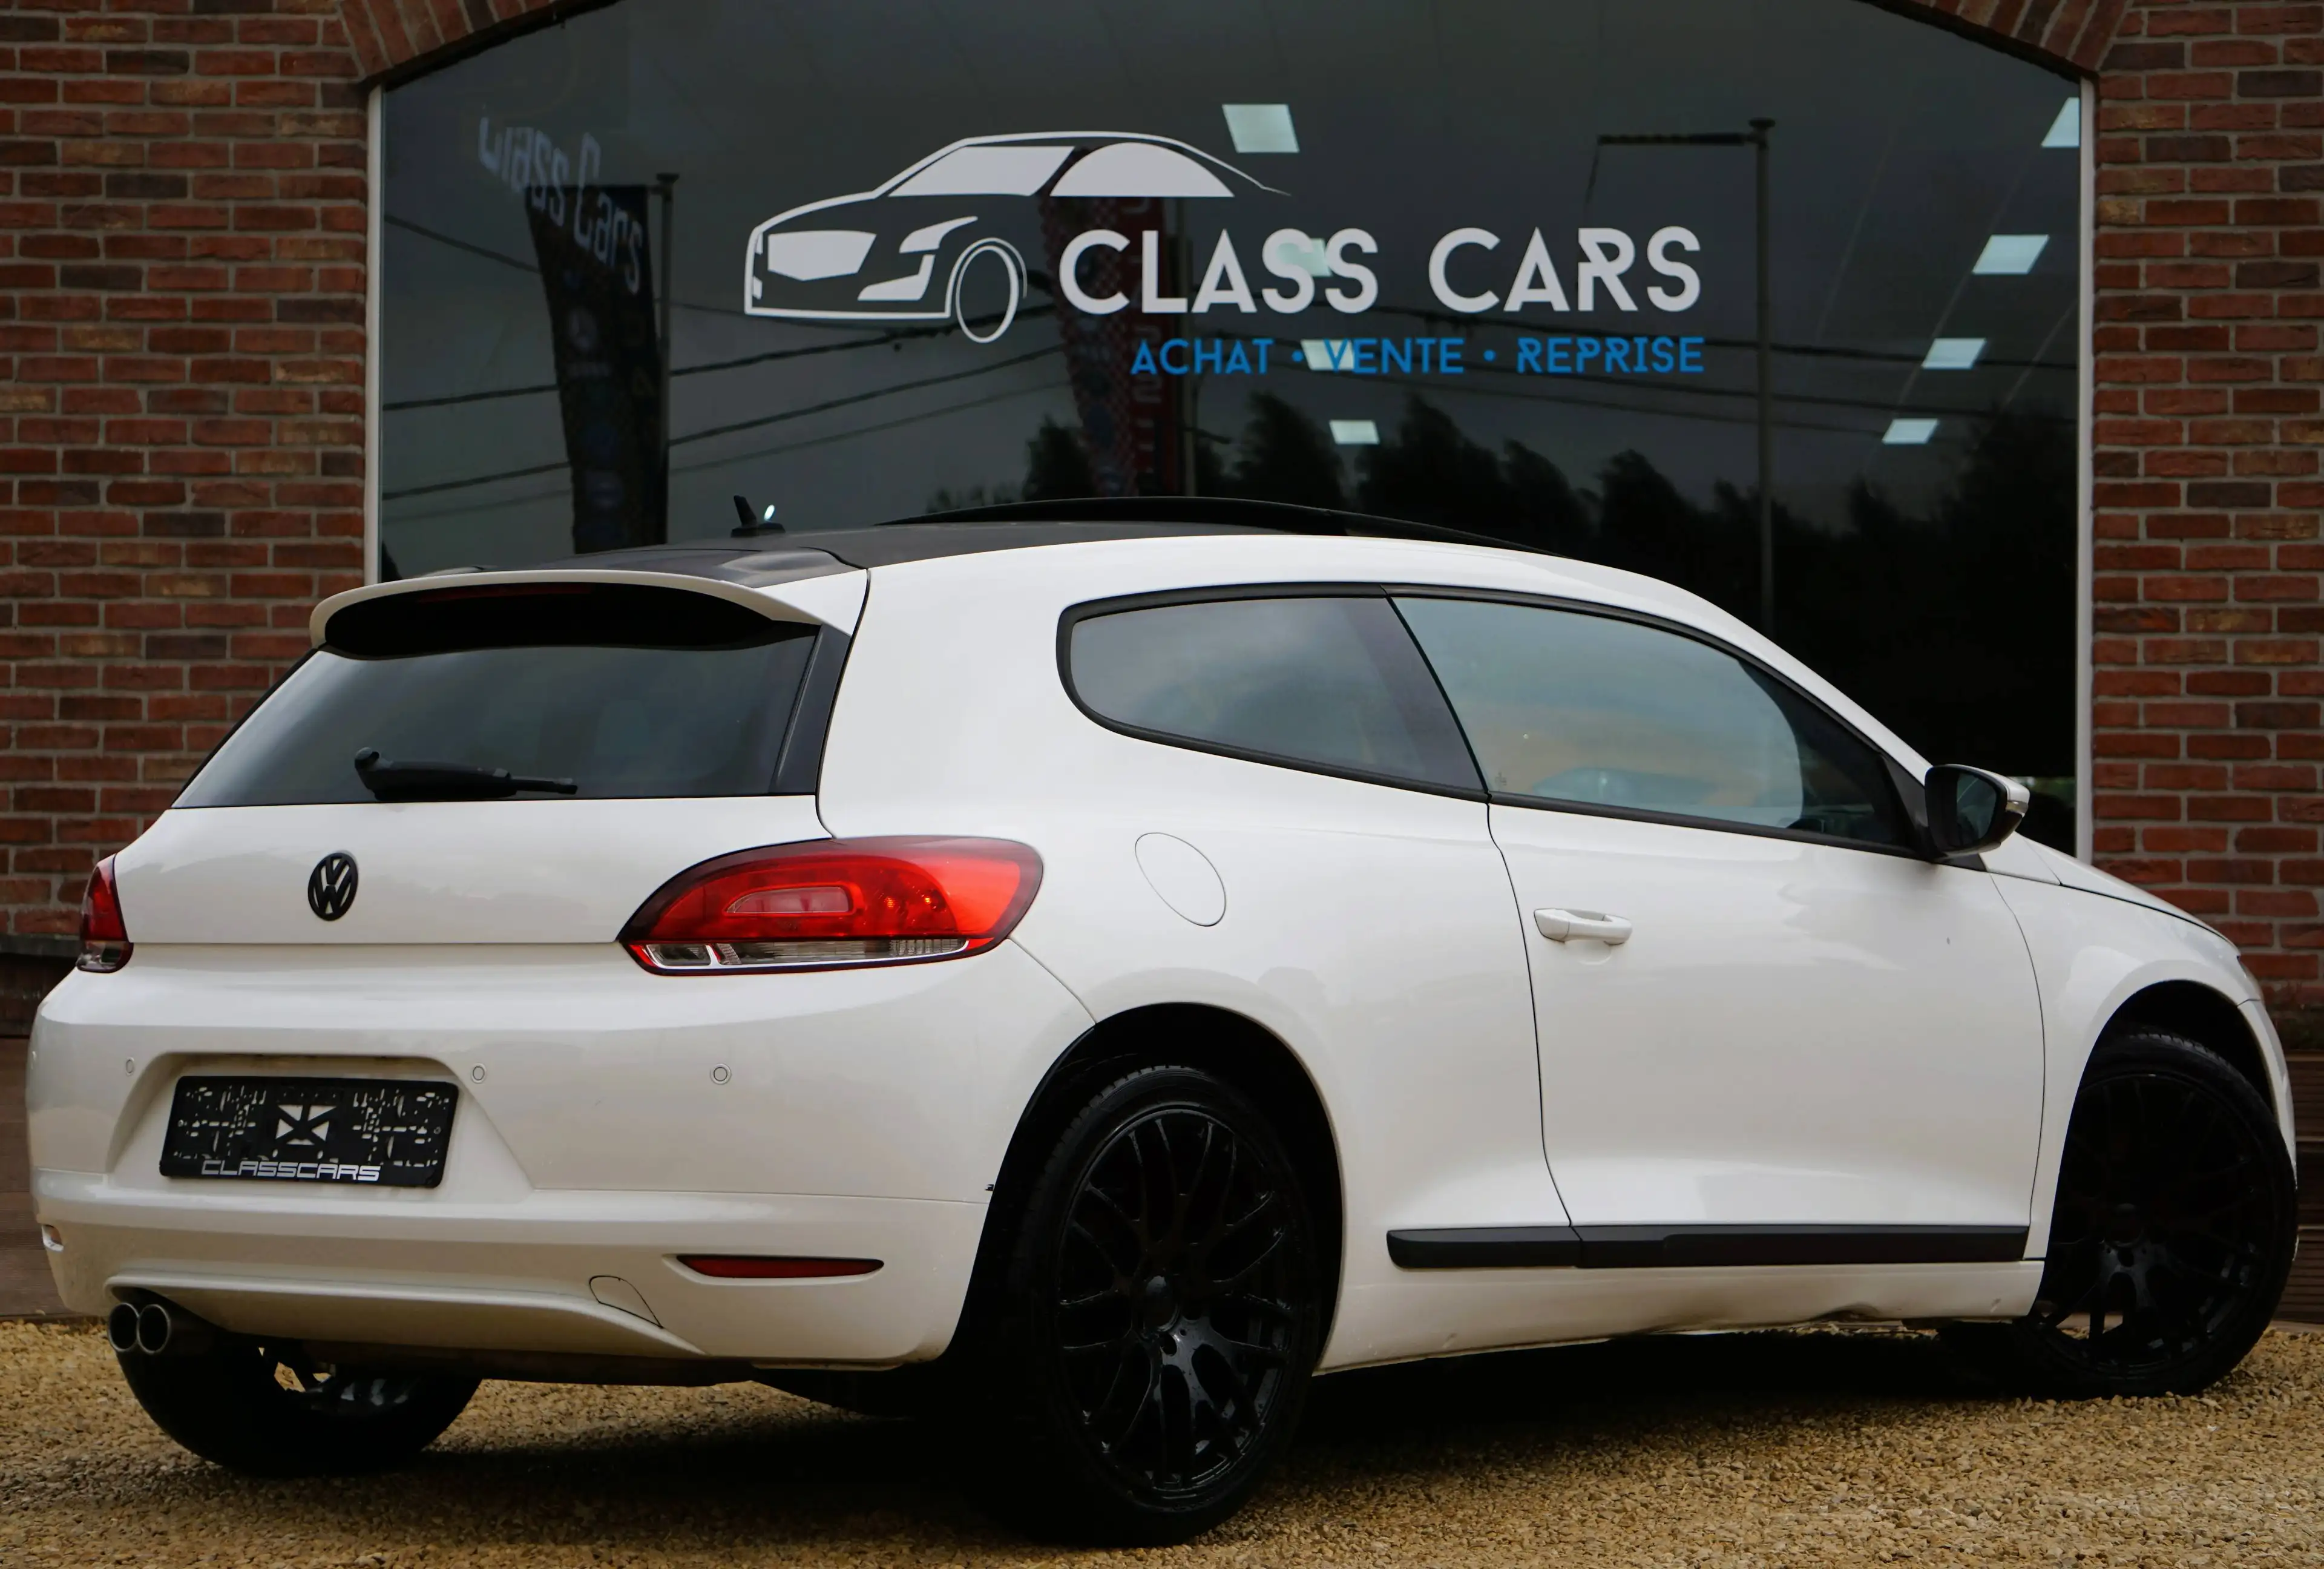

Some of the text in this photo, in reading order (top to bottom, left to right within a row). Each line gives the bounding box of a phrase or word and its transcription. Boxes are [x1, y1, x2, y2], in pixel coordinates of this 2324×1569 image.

[572, 131, 643, 296] Cars
[1060, 226, 1701, 314] CLASS CARS
[1131, 337, 1705, 375] ACHAT VENTE REPRISE
[202, 1160, 381, 1181] CLASSCARS
